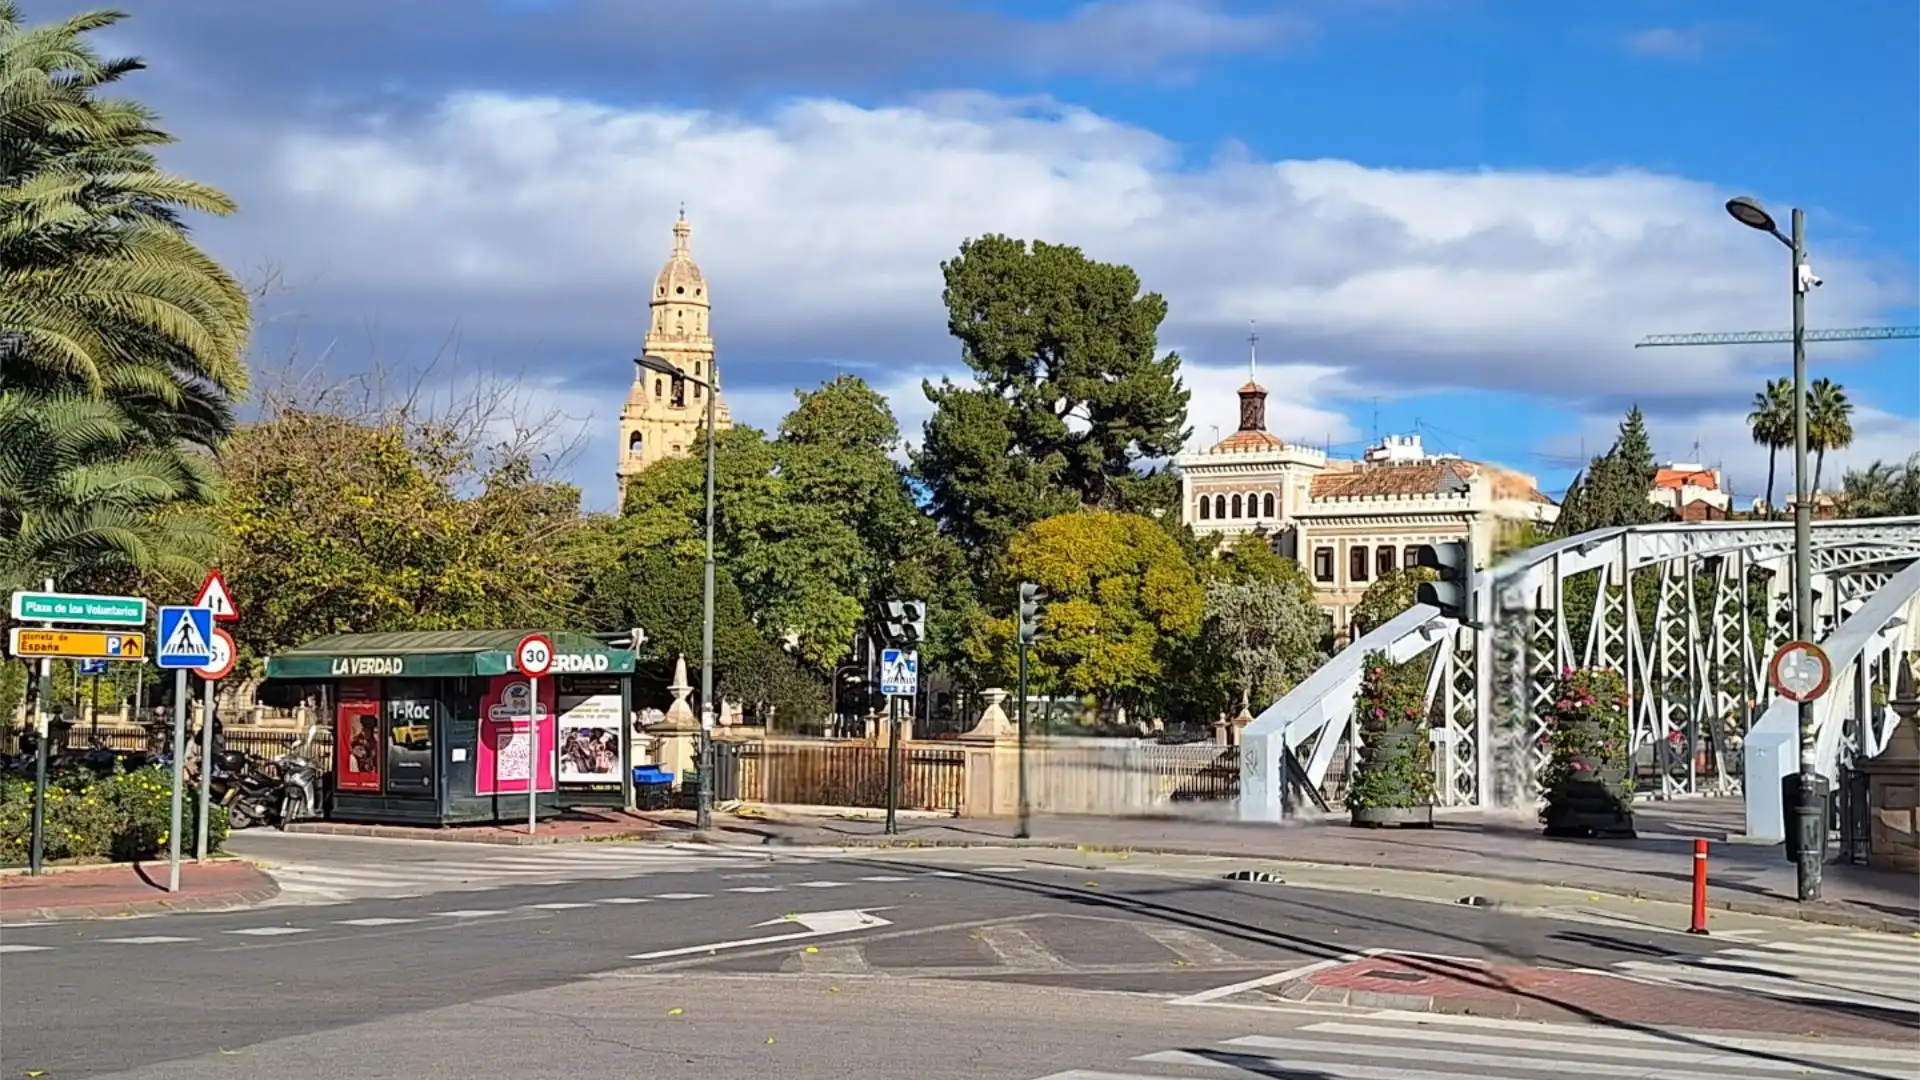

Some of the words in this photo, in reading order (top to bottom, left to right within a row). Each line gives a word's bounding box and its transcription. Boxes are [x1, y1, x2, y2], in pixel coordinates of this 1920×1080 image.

[25, 601, 52, 613] Plaza
[55, 603, 67, 614] de
[68, 603, 84, 614] los
[86, 604, 138, 616] Voluntarios
[108, 636, 120, 654] P
[526, 650, 545, 663] 30
[551, 653, 609, 671] ERDAD
[332, 657, 349, 675] LA
[350, 657, 403, 675] VERDAD
[391, 700, 430, 720] T-Roc
